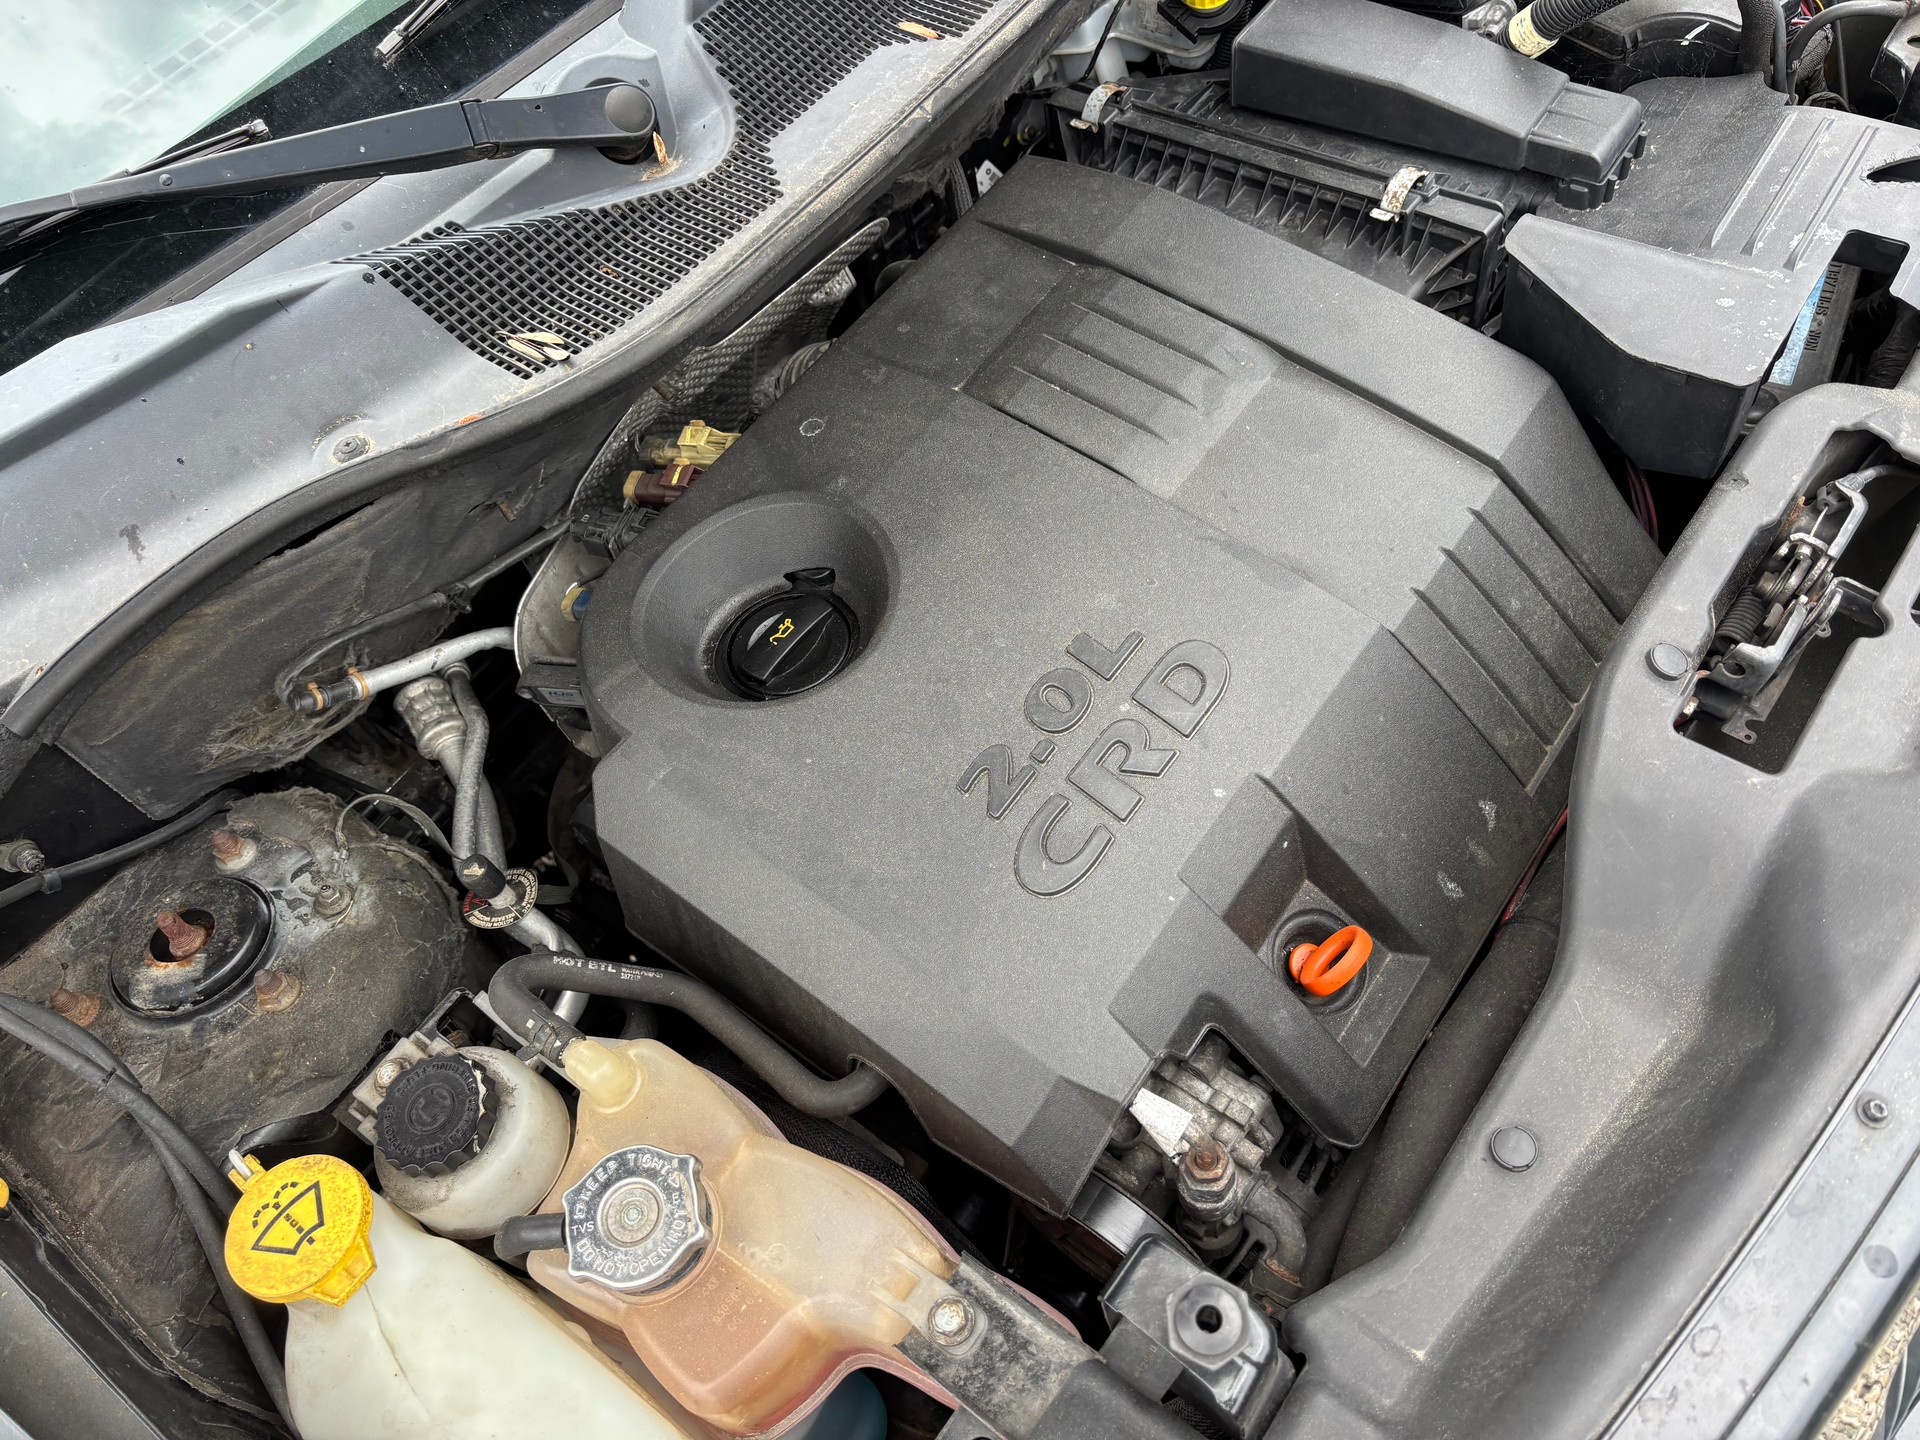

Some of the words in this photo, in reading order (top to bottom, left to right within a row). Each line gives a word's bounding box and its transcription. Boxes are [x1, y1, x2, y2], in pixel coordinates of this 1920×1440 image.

[956, 630, 1146, 822] 2.0L
[1014, 639, 1231, 899] CRD
[579, 1160, 619, 1201] KEEP
[626, 1153, 672, 1175] TIGHT
[571, 1221, 595, 1236] TVS
[629, 1245, 673, 1276] OPEN
